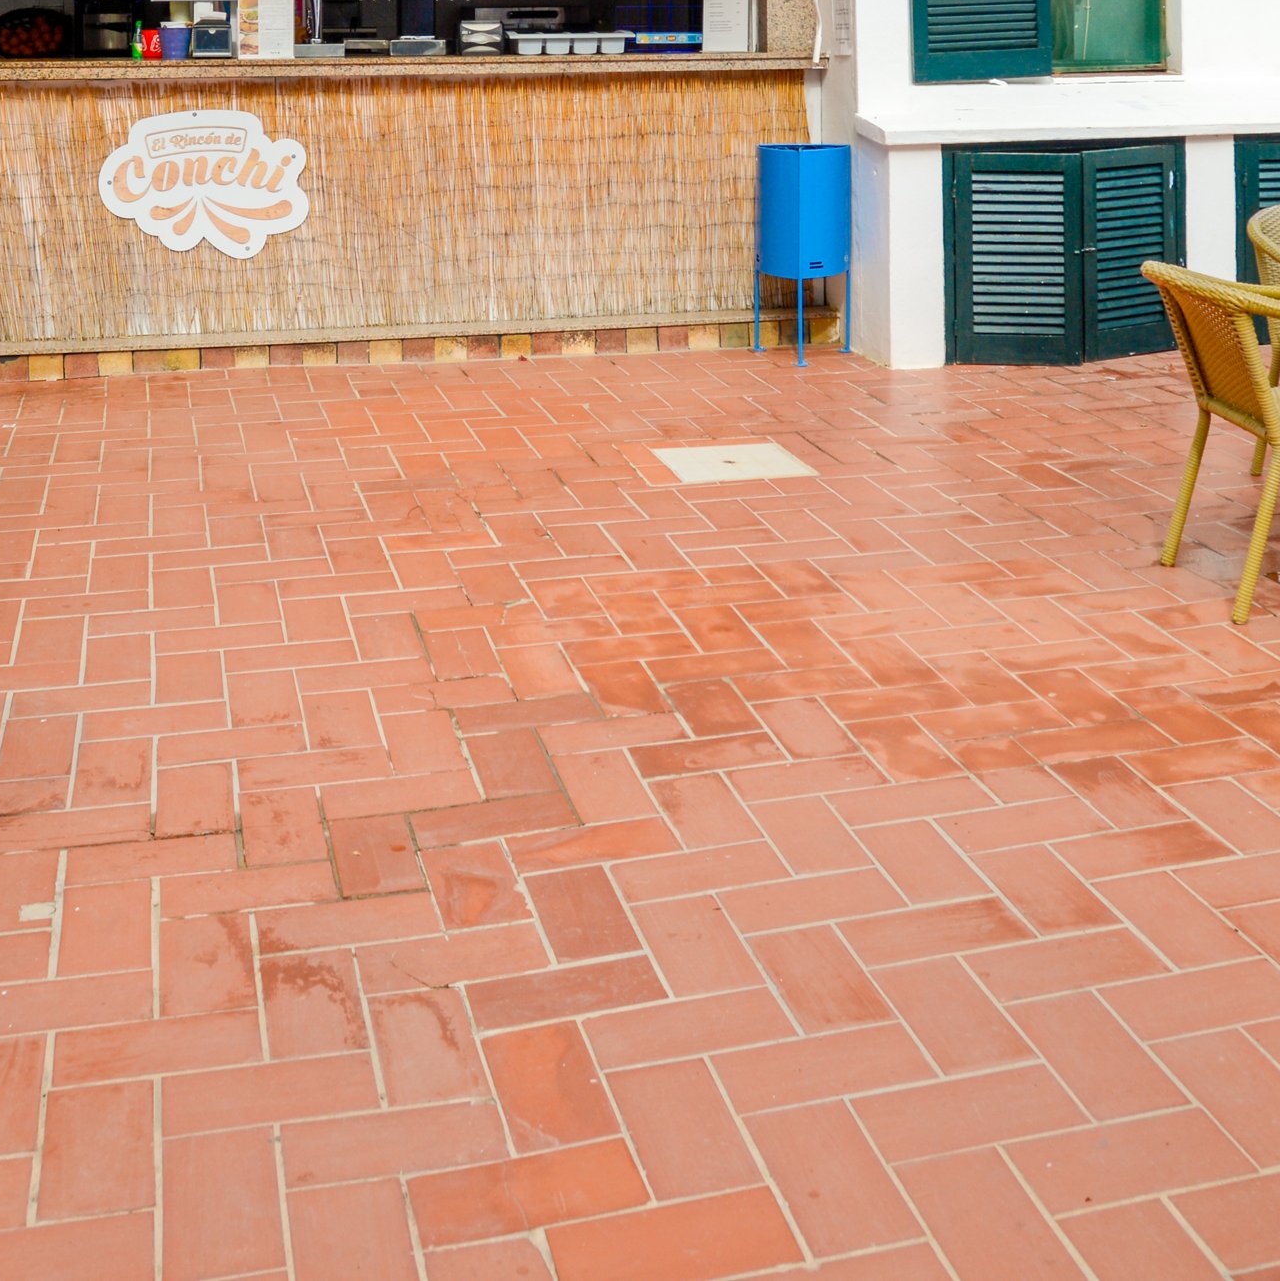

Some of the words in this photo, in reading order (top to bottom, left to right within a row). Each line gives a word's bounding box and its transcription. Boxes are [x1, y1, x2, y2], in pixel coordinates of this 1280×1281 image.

[151, 138, 166, 152] El
[169, 131, 222, 150] Rincón
[224, 132, 242, 147] de
[113, 147, 293, 203] Conchi
